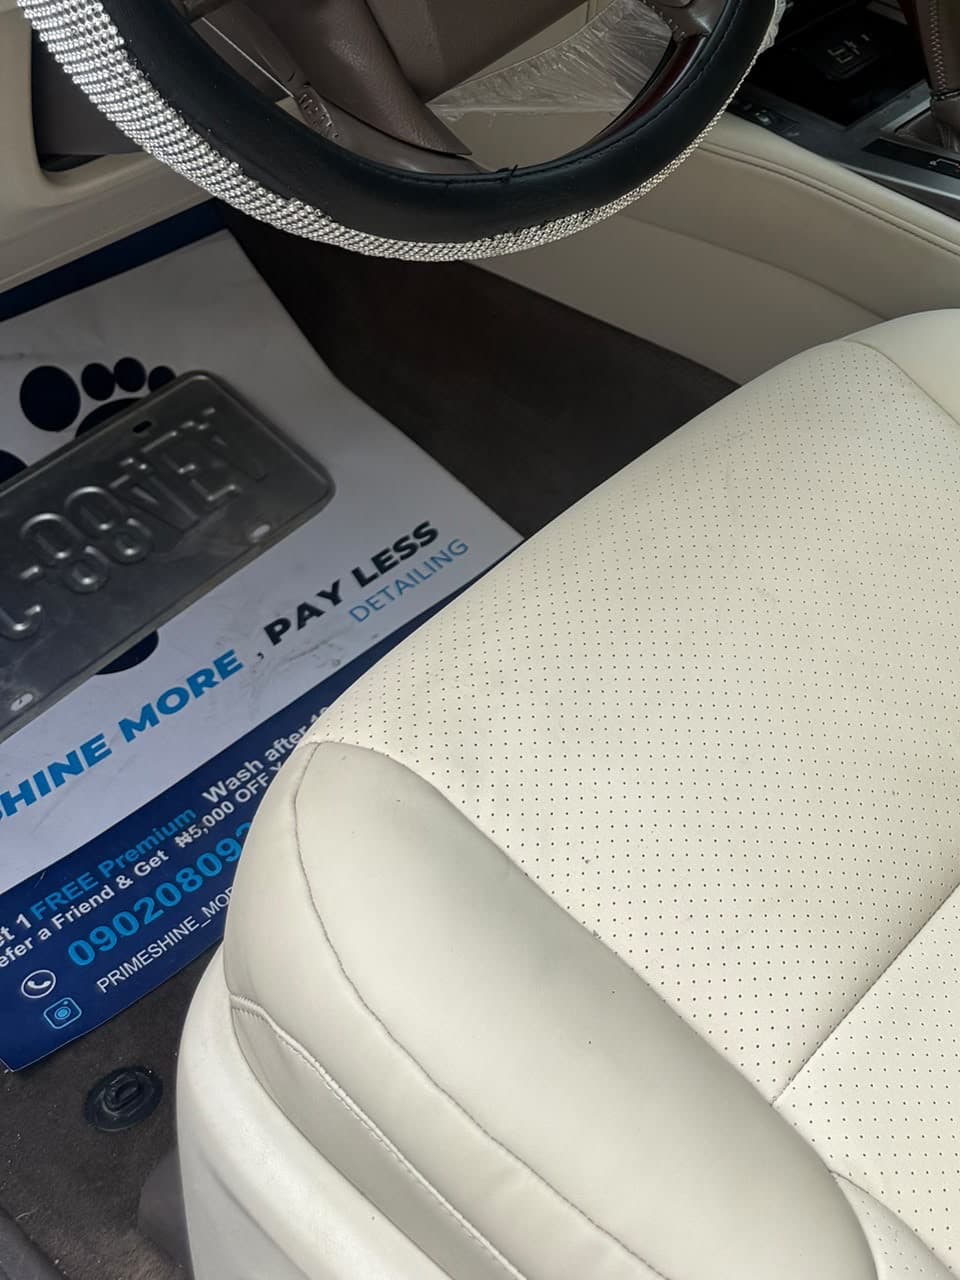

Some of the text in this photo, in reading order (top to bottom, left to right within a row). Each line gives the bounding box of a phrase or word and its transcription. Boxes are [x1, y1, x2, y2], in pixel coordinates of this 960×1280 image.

[0, 733, 112, 819] HINE
[118, 649, 244, 742] MORE
[263, 579, 342, 646] PAY
[351, 521, 438, 587] LESS
[348, 538, 469, 623] DETAILING
[30, 872, 99, 920] FREE
[97, 808, 197, 878] Premium
[202, 759, 264, 804] Wash
[265, 725, 307, 760] after
[37, 928, 52, 940] a
[51, 885, 115, 930] Friend
[115, 875, 134, 889] &
[134, 850, 169, 877] Get
[235, 772, 269, 803] OFF
